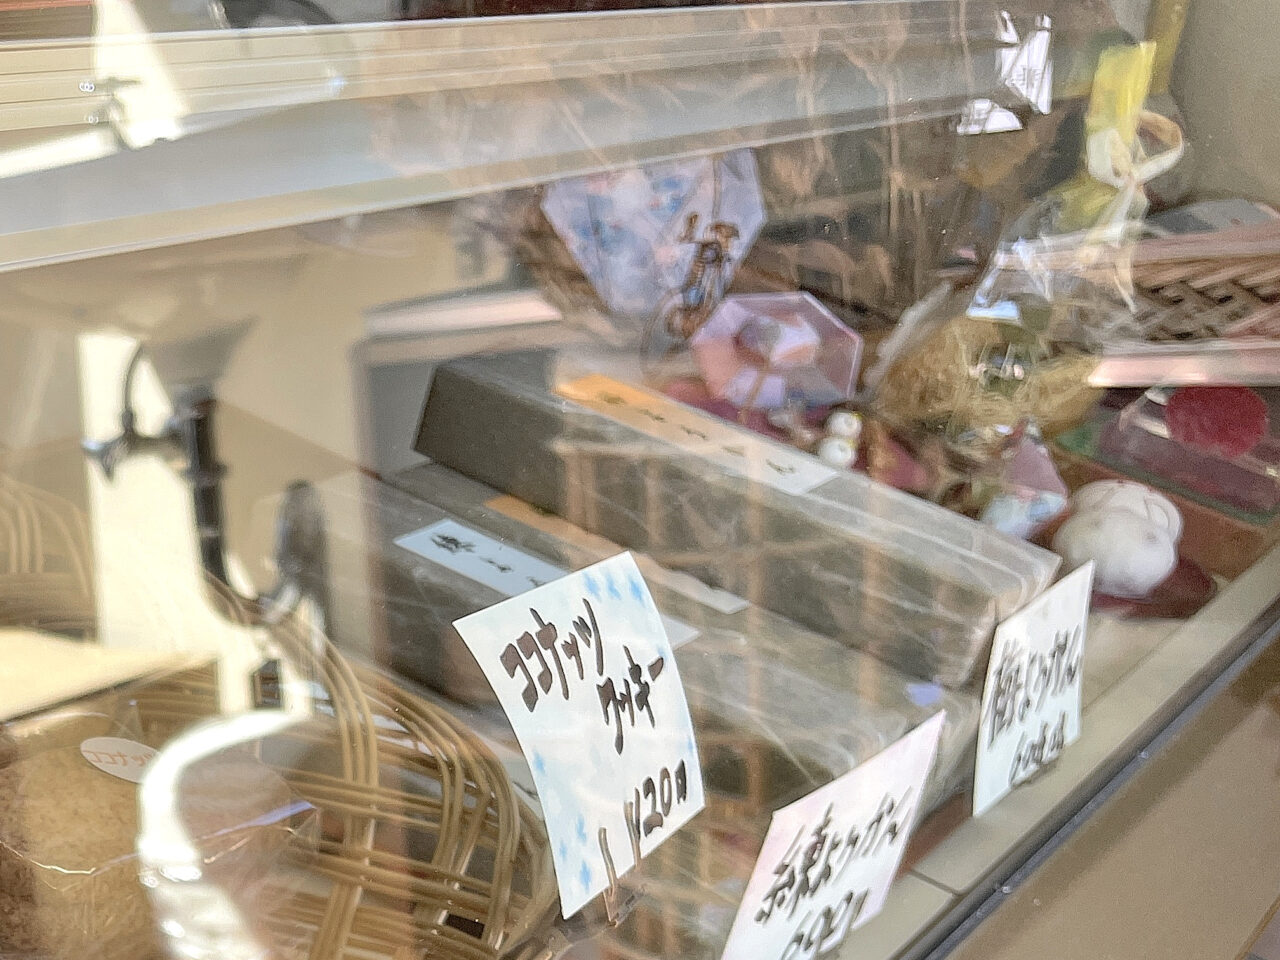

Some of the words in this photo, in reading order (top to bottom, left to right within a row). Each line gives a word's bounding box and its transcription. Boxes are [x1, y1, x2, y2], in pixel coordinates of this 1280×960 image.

[500, 598, 605, 713] ココナッツ
[596, 645, 665, 755] クッキー
[633, 760, 688, 839] 120円
